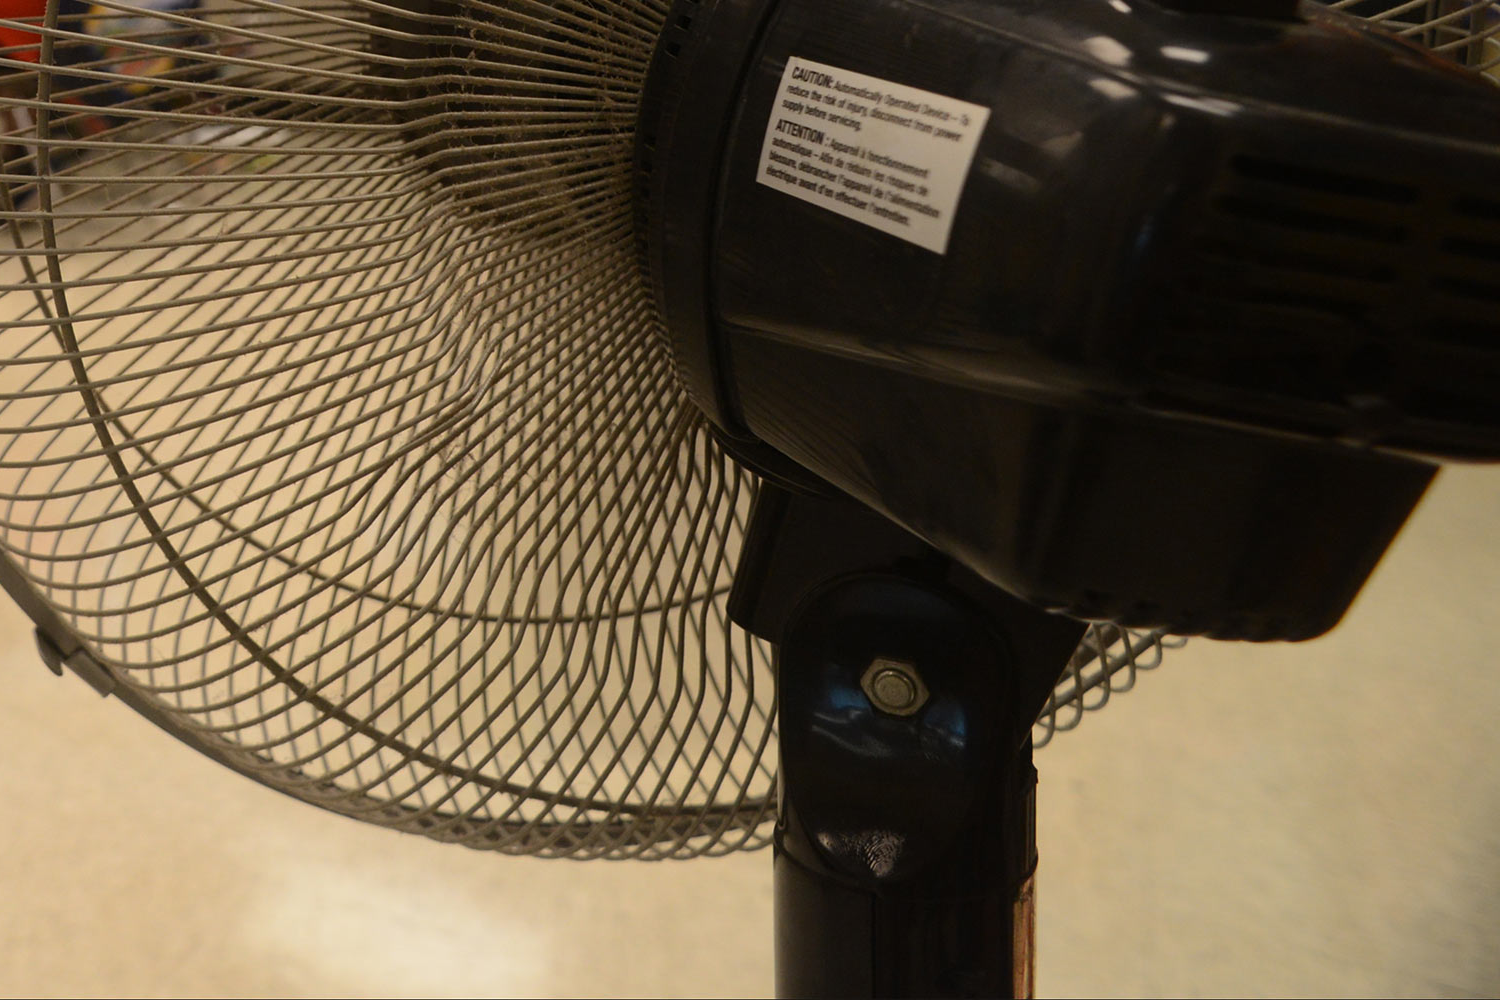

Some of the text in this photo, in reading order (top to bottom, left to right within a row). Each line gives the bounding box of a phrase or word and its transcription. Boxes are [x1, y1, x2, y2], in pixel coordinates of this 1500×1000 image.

[792, 67, 834, 88] CAUTION:
[833, 81, 882, 105] Automatically
[782, 99, 804, 114] supply
[804, 104, 827, 119] before
[786, 85, 809, 98] reduce
[810, 90, 822, 102] the
[822, 95, 836, 106] risk
[837, 99, 846, 108] of
[870, 107, 912, 128] disconnect
[913, 120, 933, 134] from
[932, 127, 962, 142] power
[775, 118, 825, 144] ATTENTION
[772, 137, 813, 158] automatique
[835, 158, 844, 169] de
[798, 178, 818, 192] avant
[873, 187, 884, 199] de
